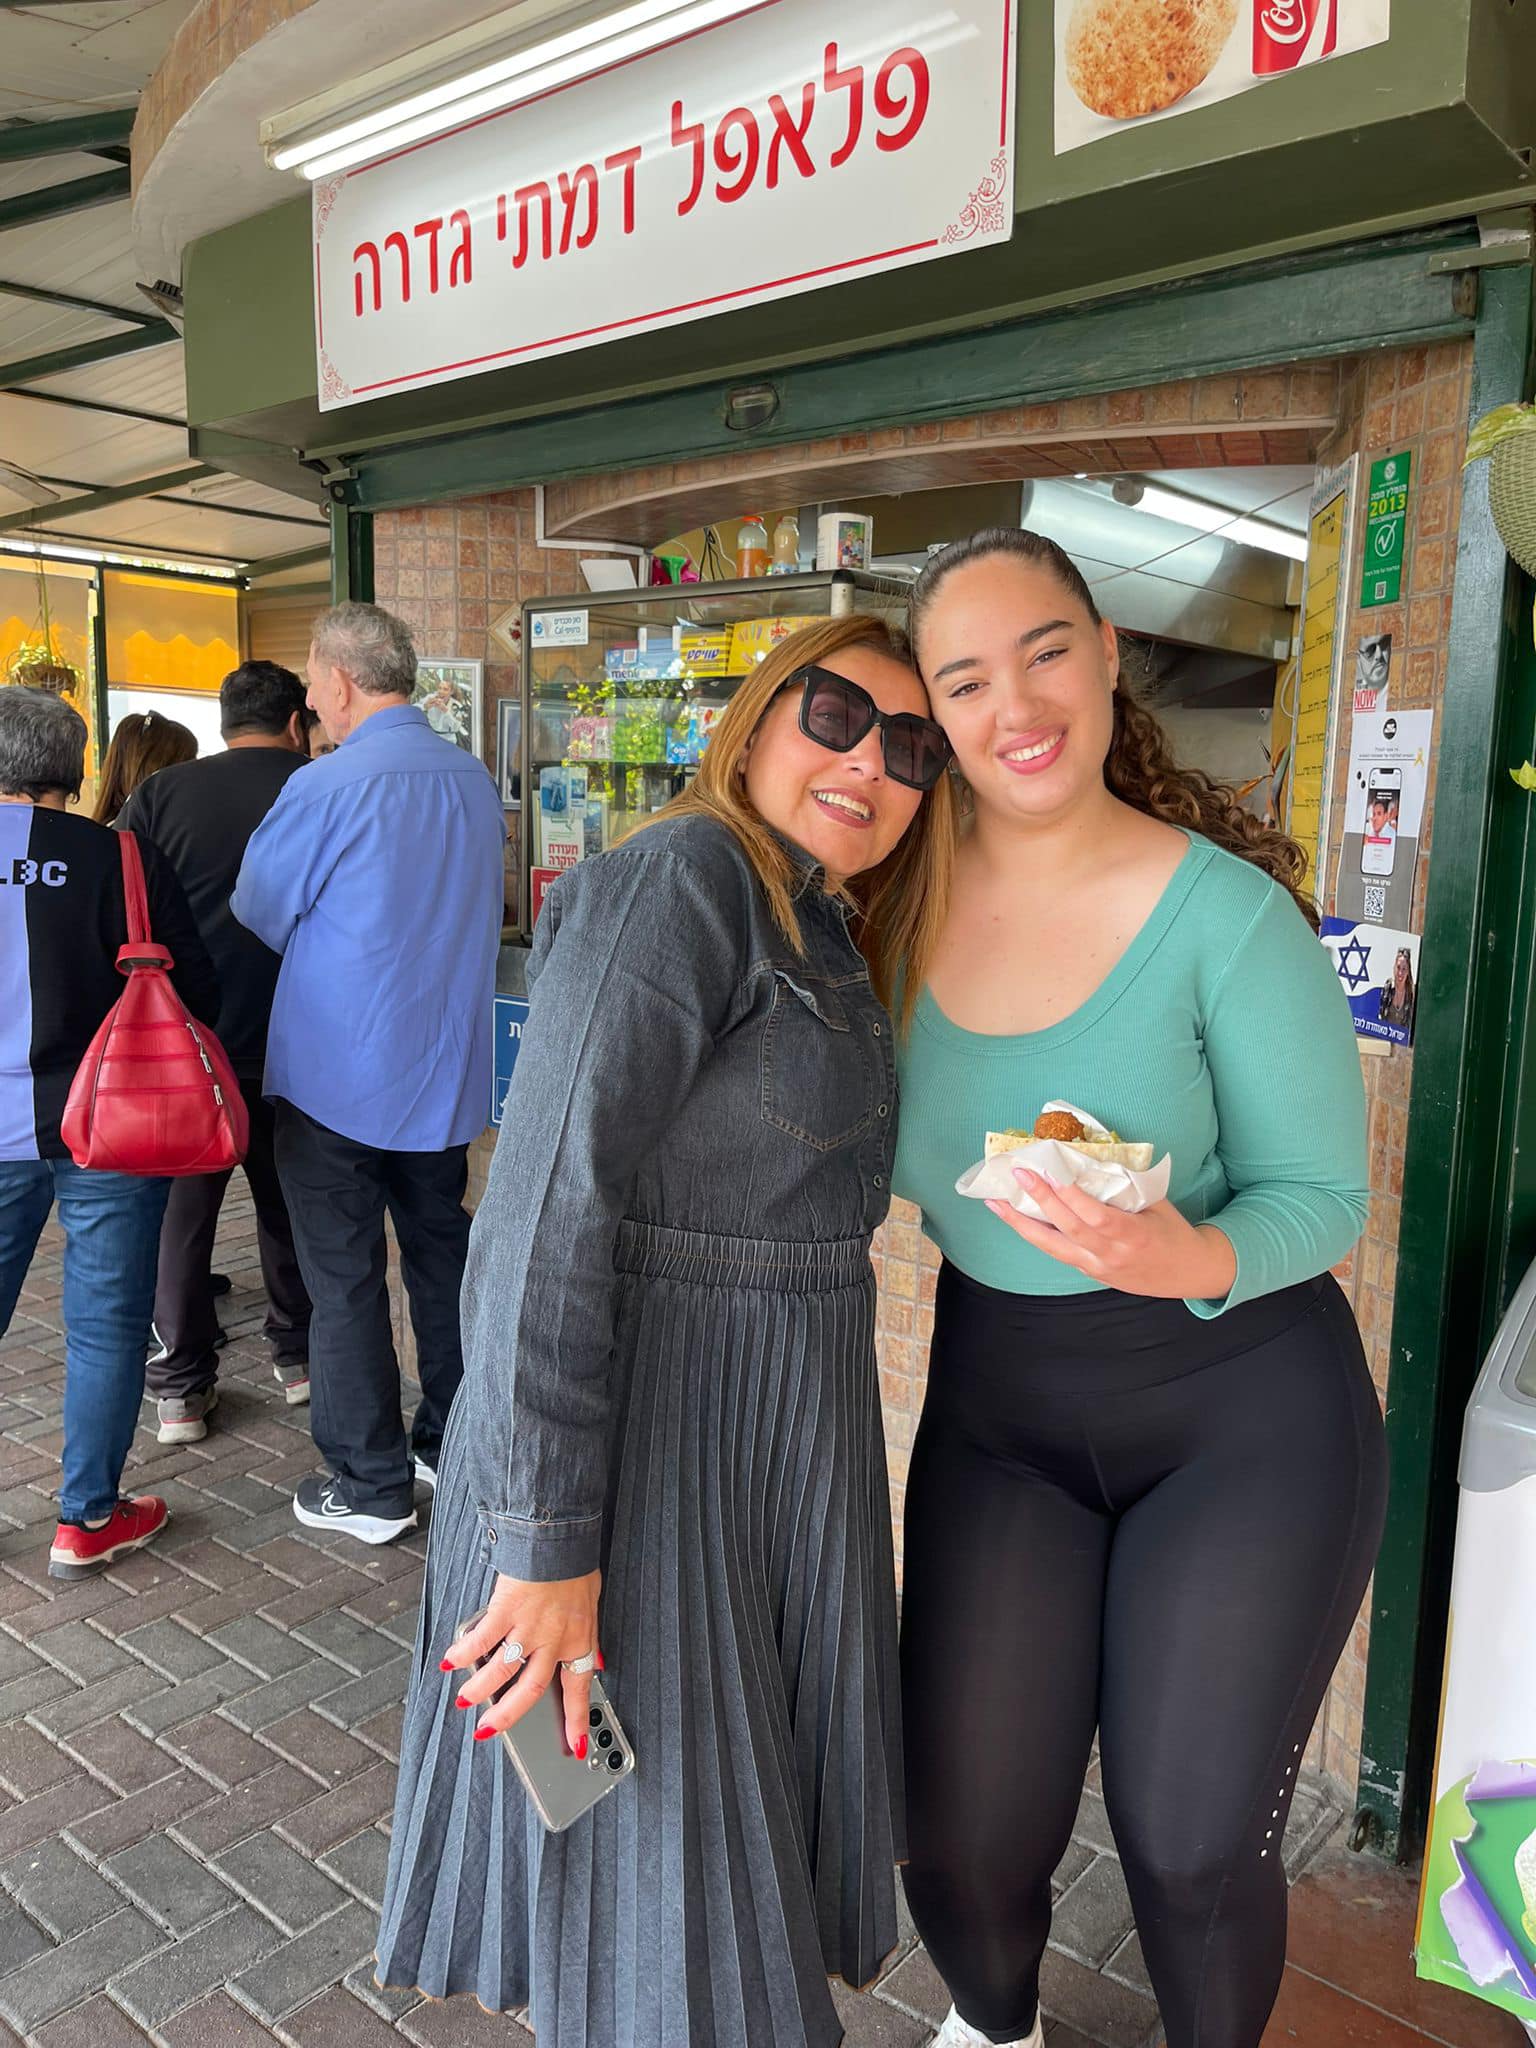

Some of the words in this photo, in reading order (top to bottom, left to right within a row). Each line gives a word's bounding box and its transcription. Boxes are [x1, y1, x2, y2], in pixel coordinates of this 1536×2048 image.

[671, 42, 930, 216] פלאפל
[353, 209, 471, 316] גדרה
[497, 146, 640, 269] דמתי
[1370, 493, 1406, 517] 2013
